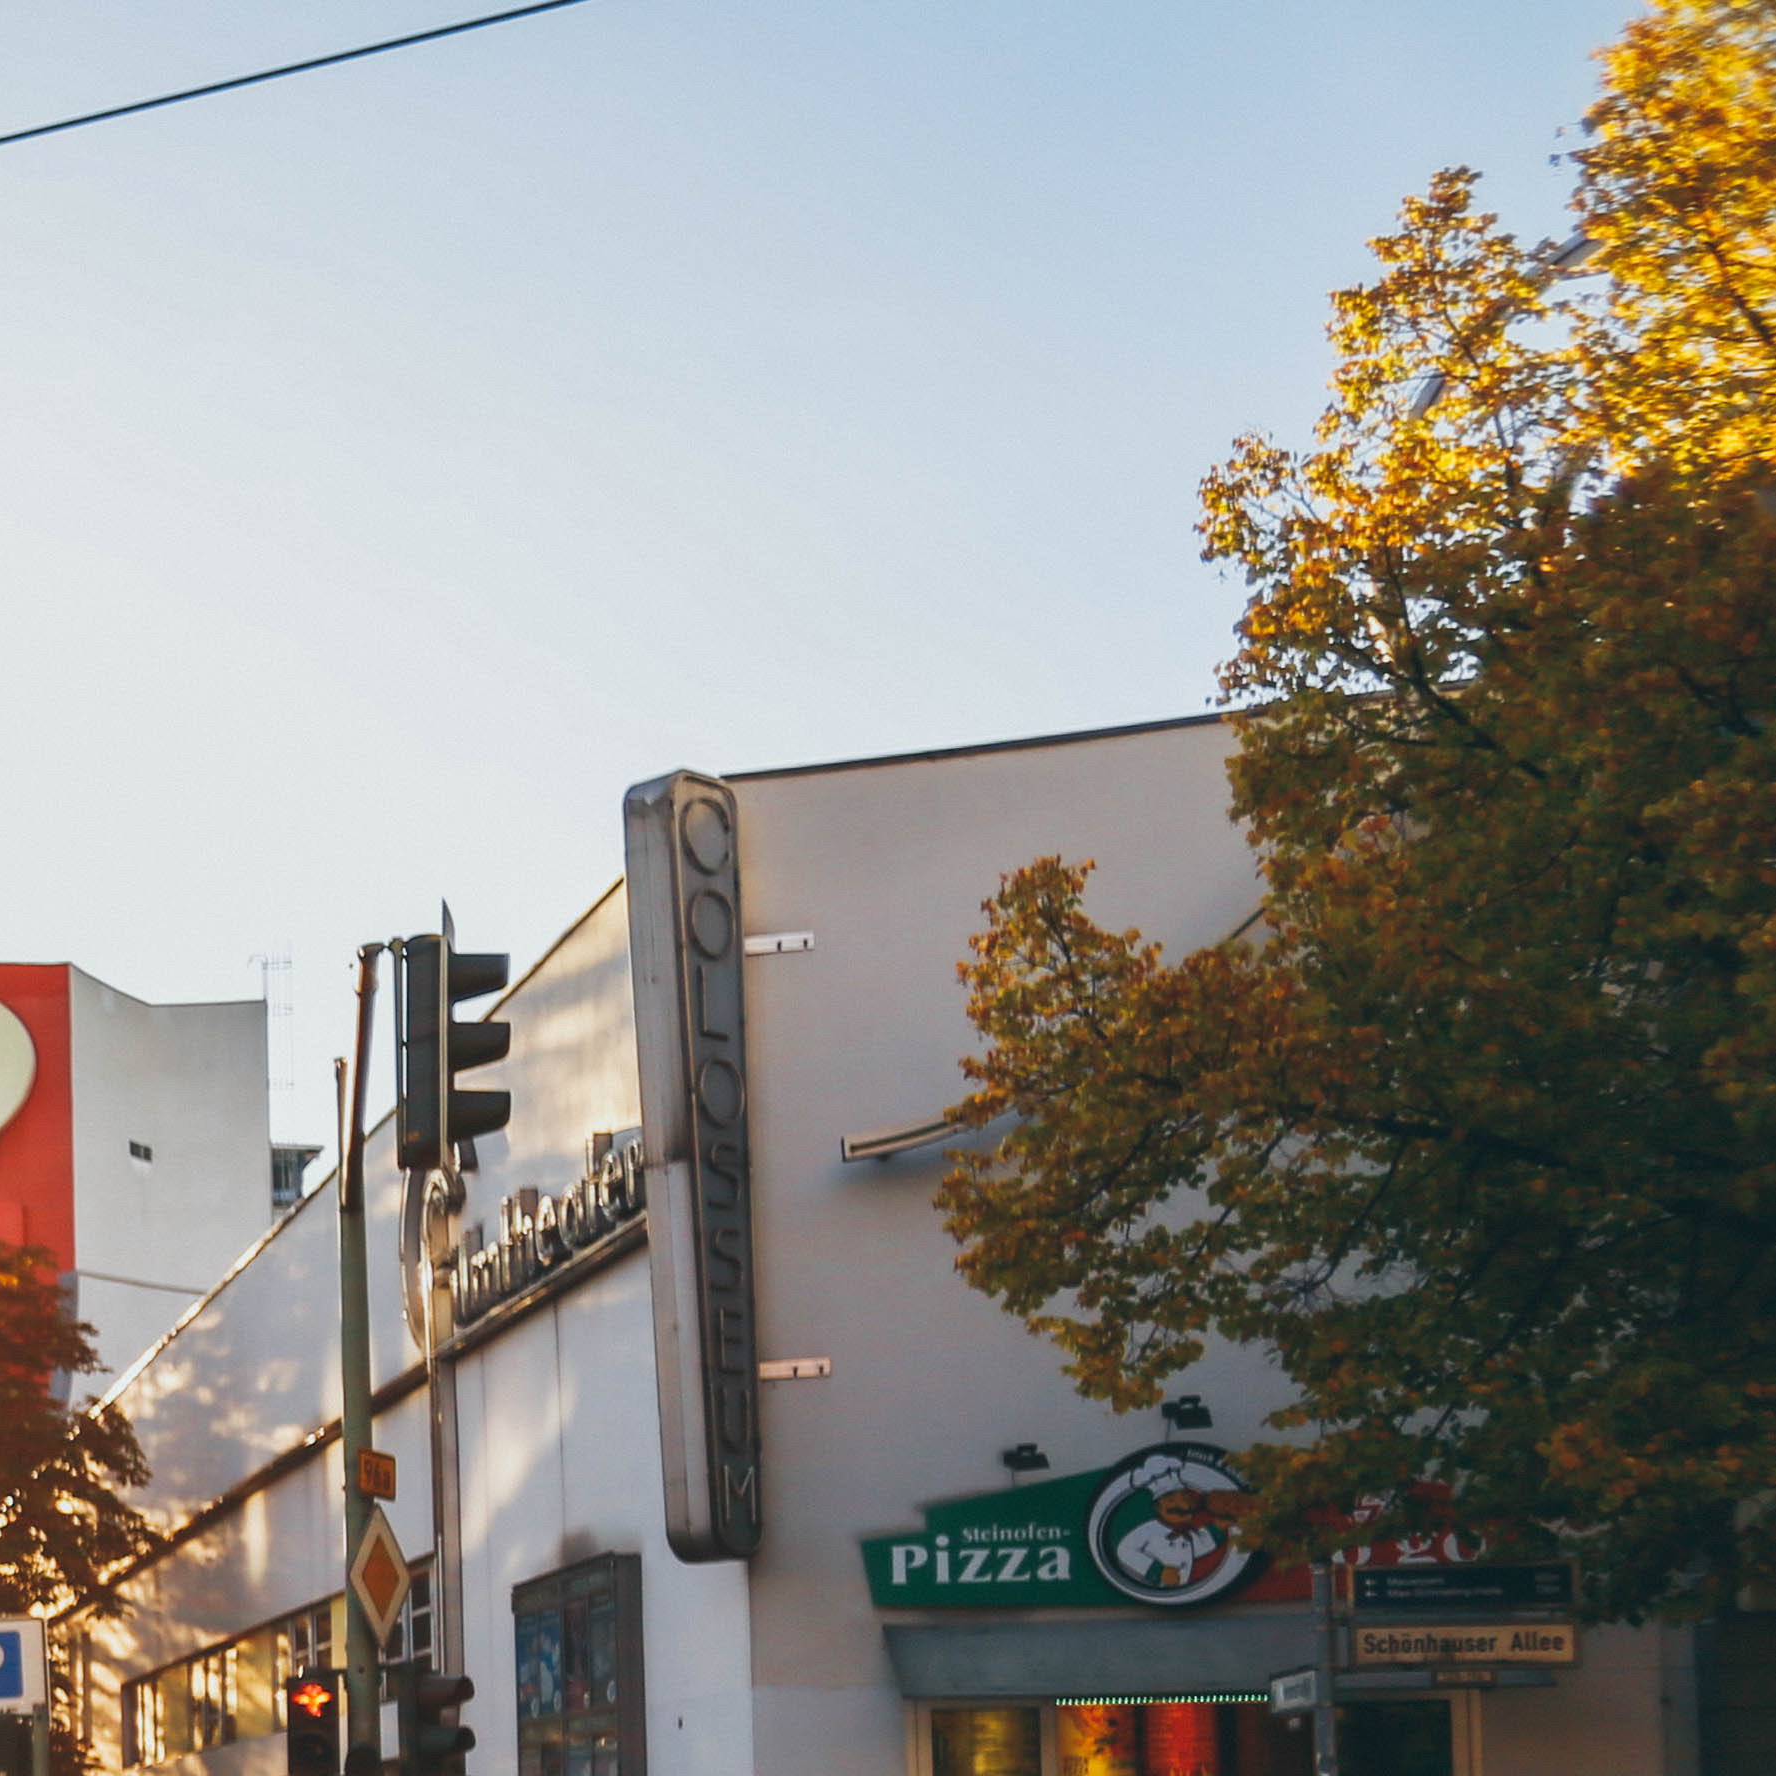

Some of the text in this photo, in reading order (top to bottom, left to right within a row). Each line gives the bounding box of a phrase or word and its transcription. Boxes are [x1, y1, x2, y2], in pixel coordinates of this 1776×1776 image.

[679, 796, 758, 1525] COLOSSEUM
[961, 1521, 1072, 1543] Steinofen-
[891, 1534, 1072, 1585] Pizza
[1363, 1630, 1566, 1655] Schönhauser Allee
